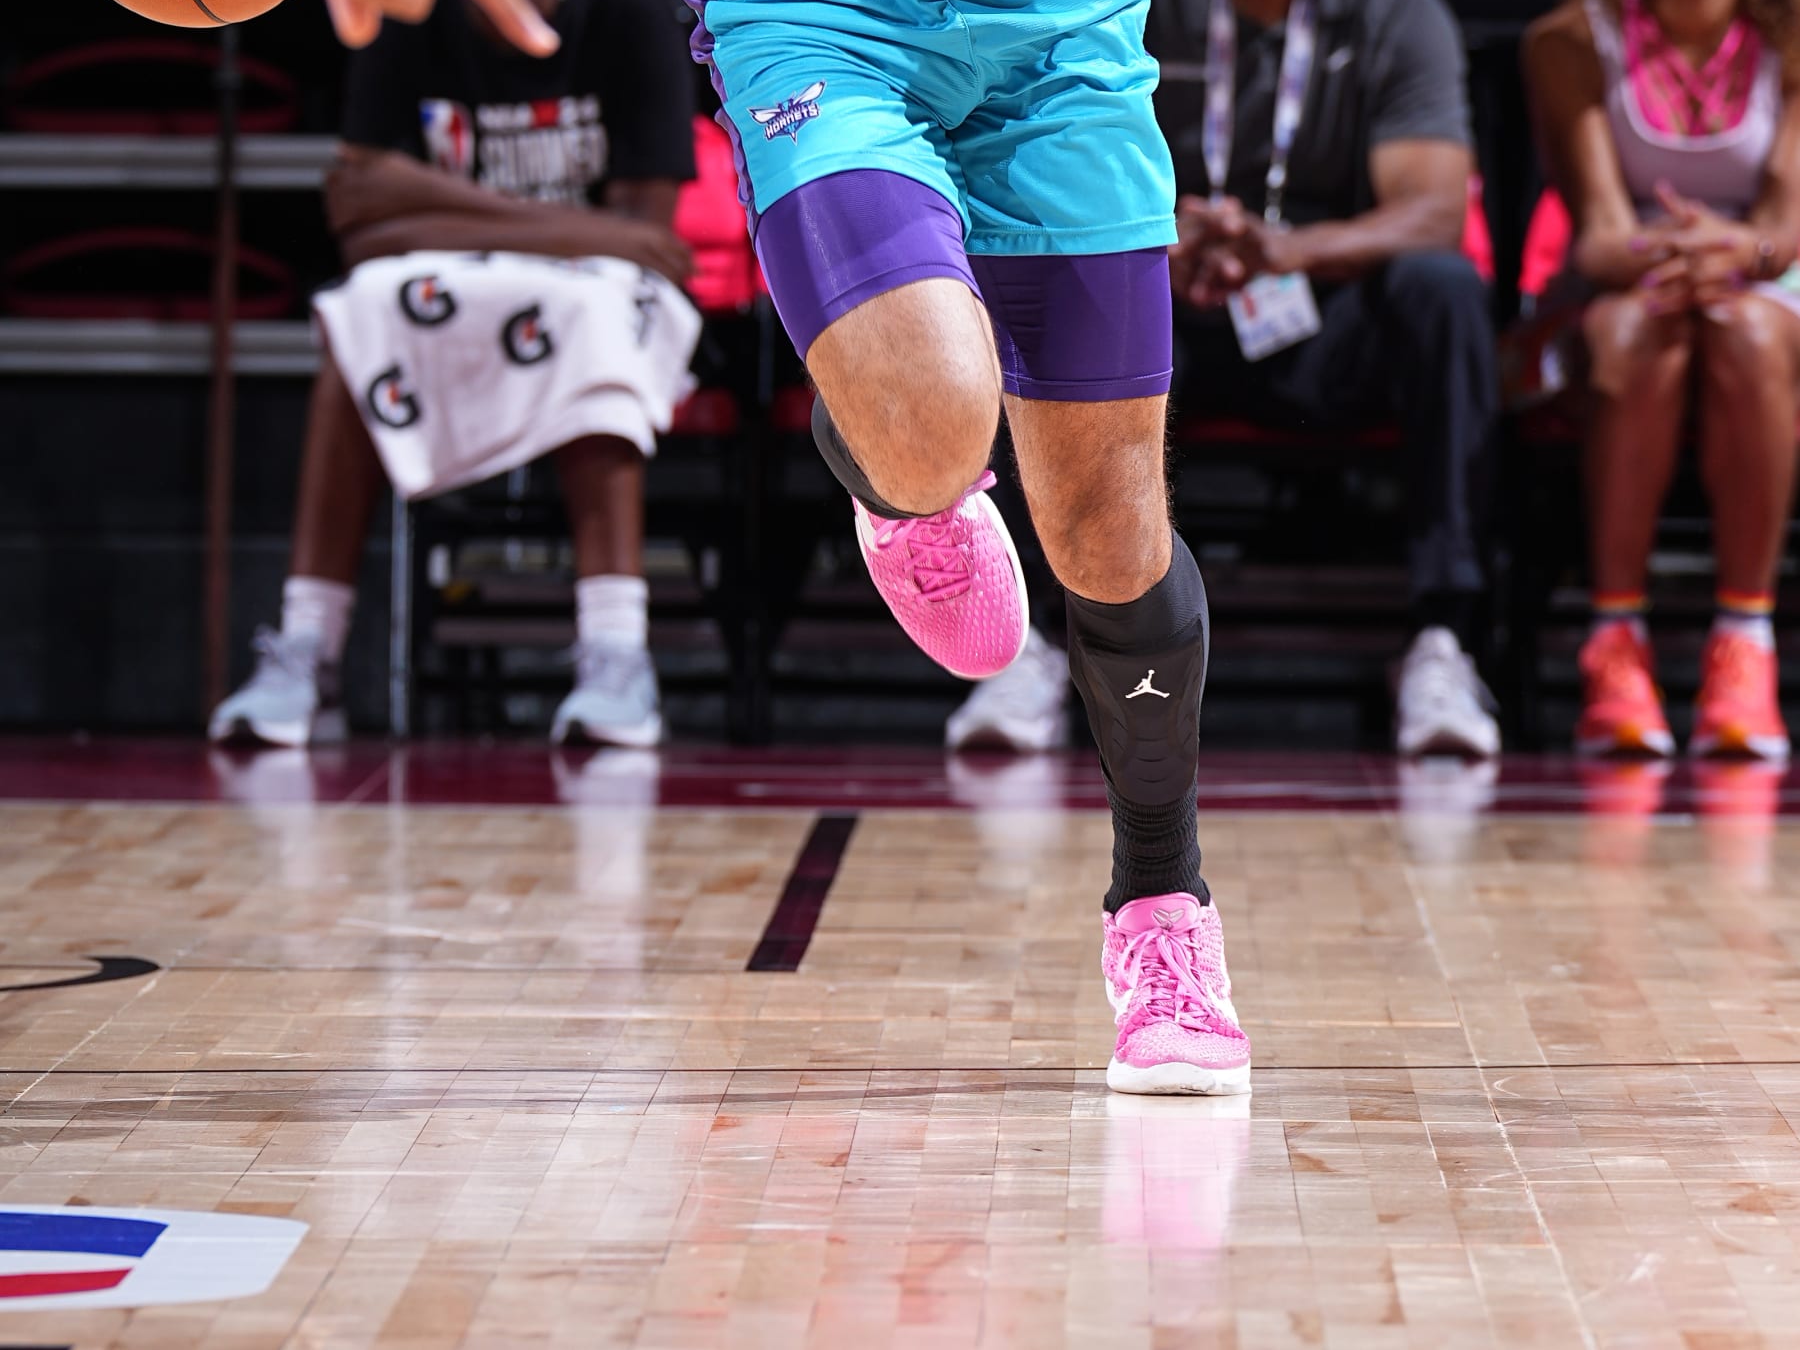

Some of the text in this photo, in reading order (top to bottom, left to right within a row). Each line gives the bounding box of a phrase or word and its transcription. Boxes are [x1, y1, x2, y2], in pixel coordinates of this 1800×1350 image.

[766, 103, 818, 138] HORNETS
[399, 274, 458, 328] G
[501, 303, 554, 366] G
[367, 363, 421, 429] G
